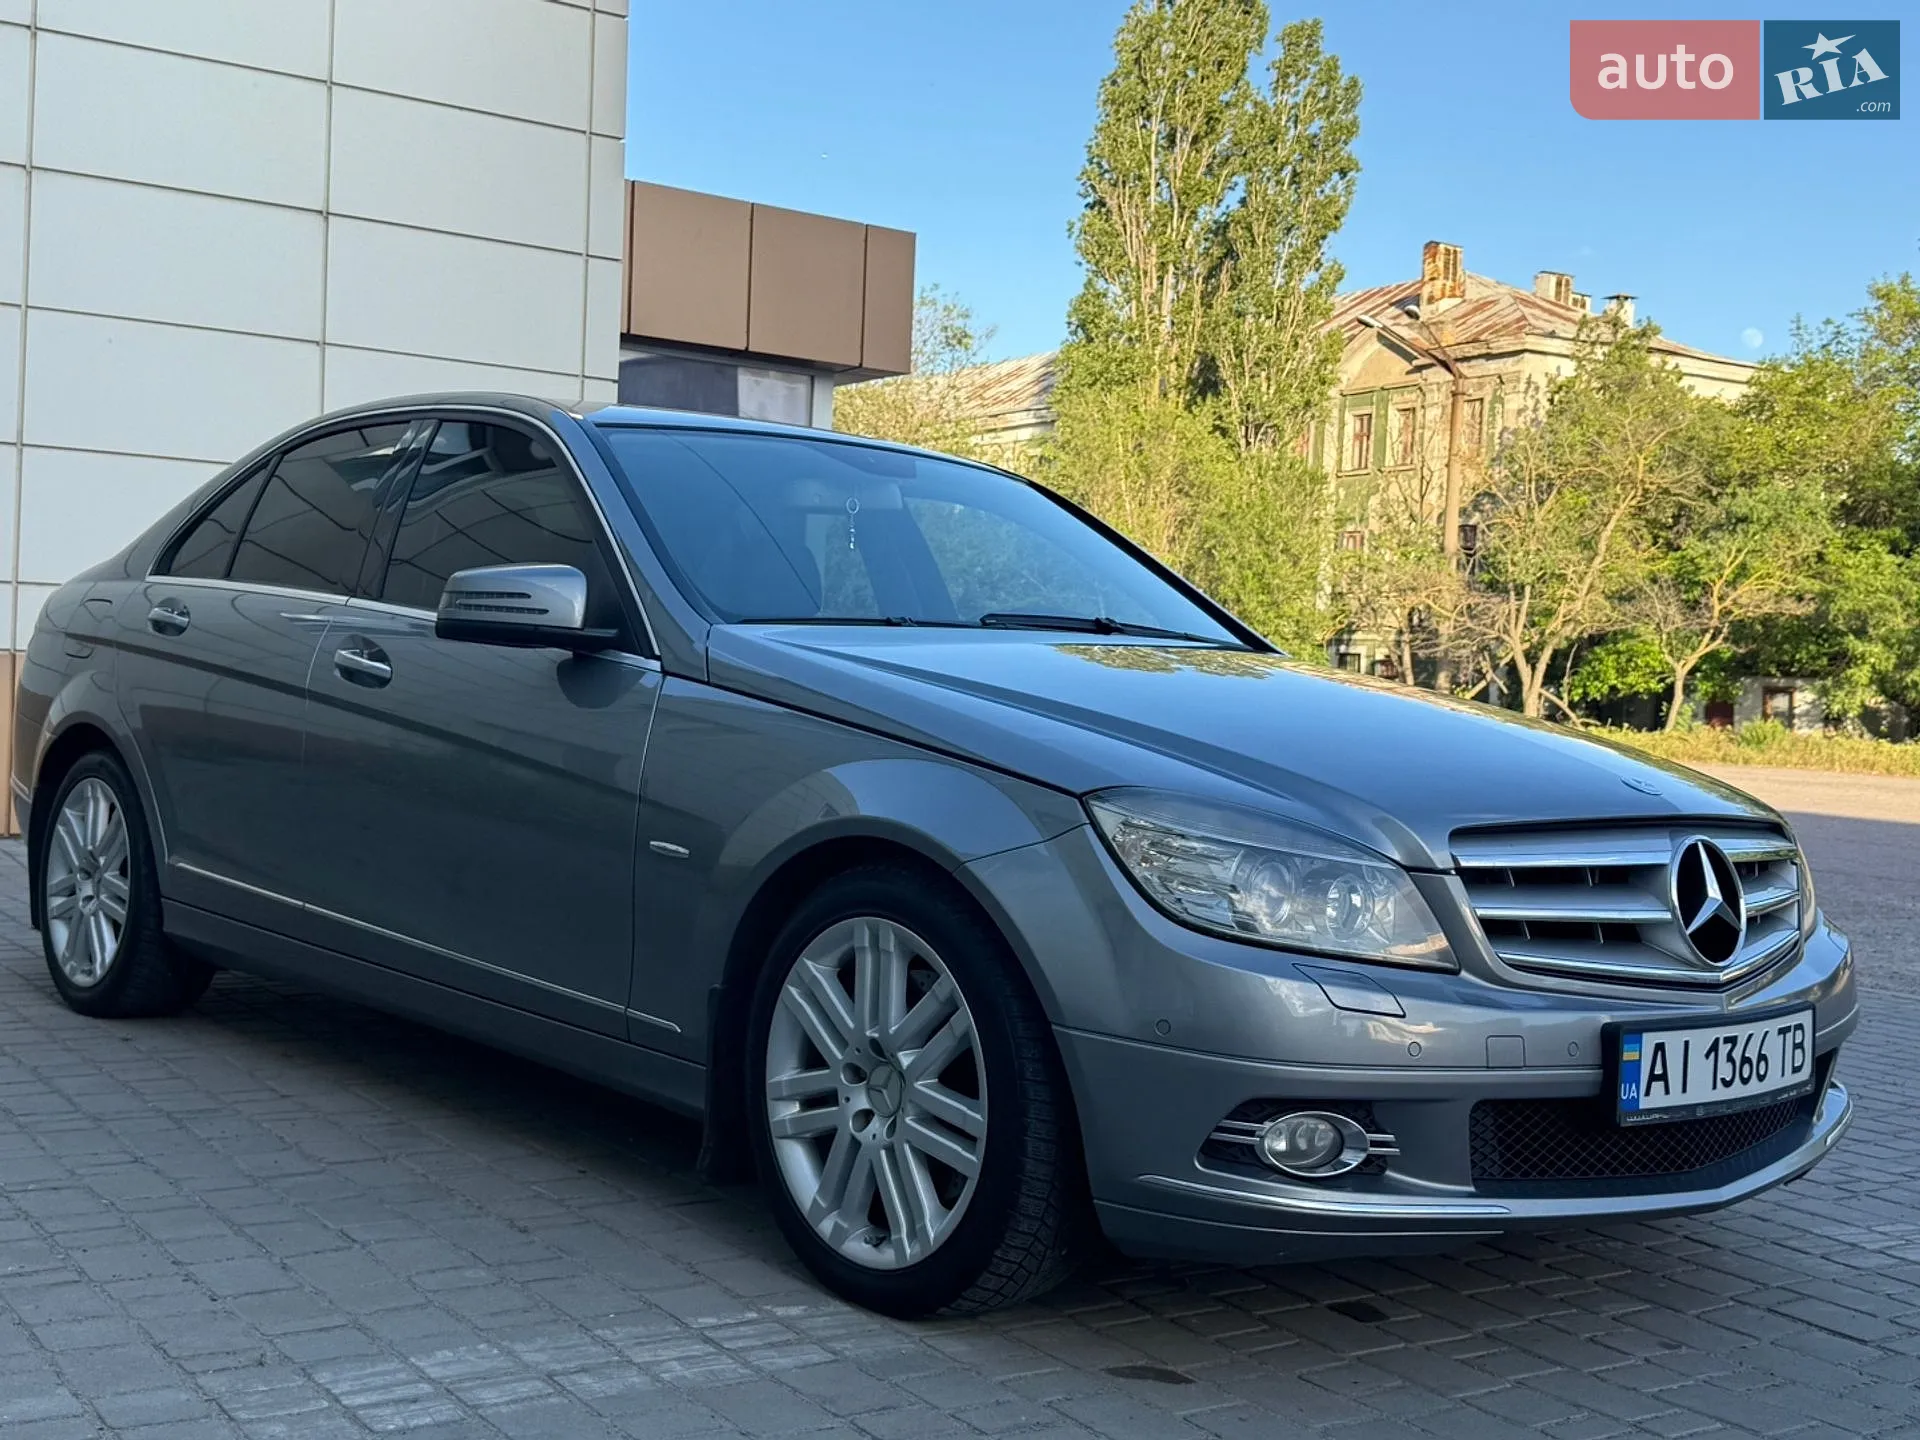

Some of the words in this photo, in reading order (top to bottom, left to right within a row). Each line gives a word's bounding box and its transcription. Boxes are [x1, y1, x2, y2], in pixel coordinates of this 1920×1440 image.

[1643, 1039, 1690, 1098] AI
[1704, 1030, 1769, 1090] 1366
[1777, 1022, 1806, 1078] TB
[1620, 1082, 1638, 1100] UA
